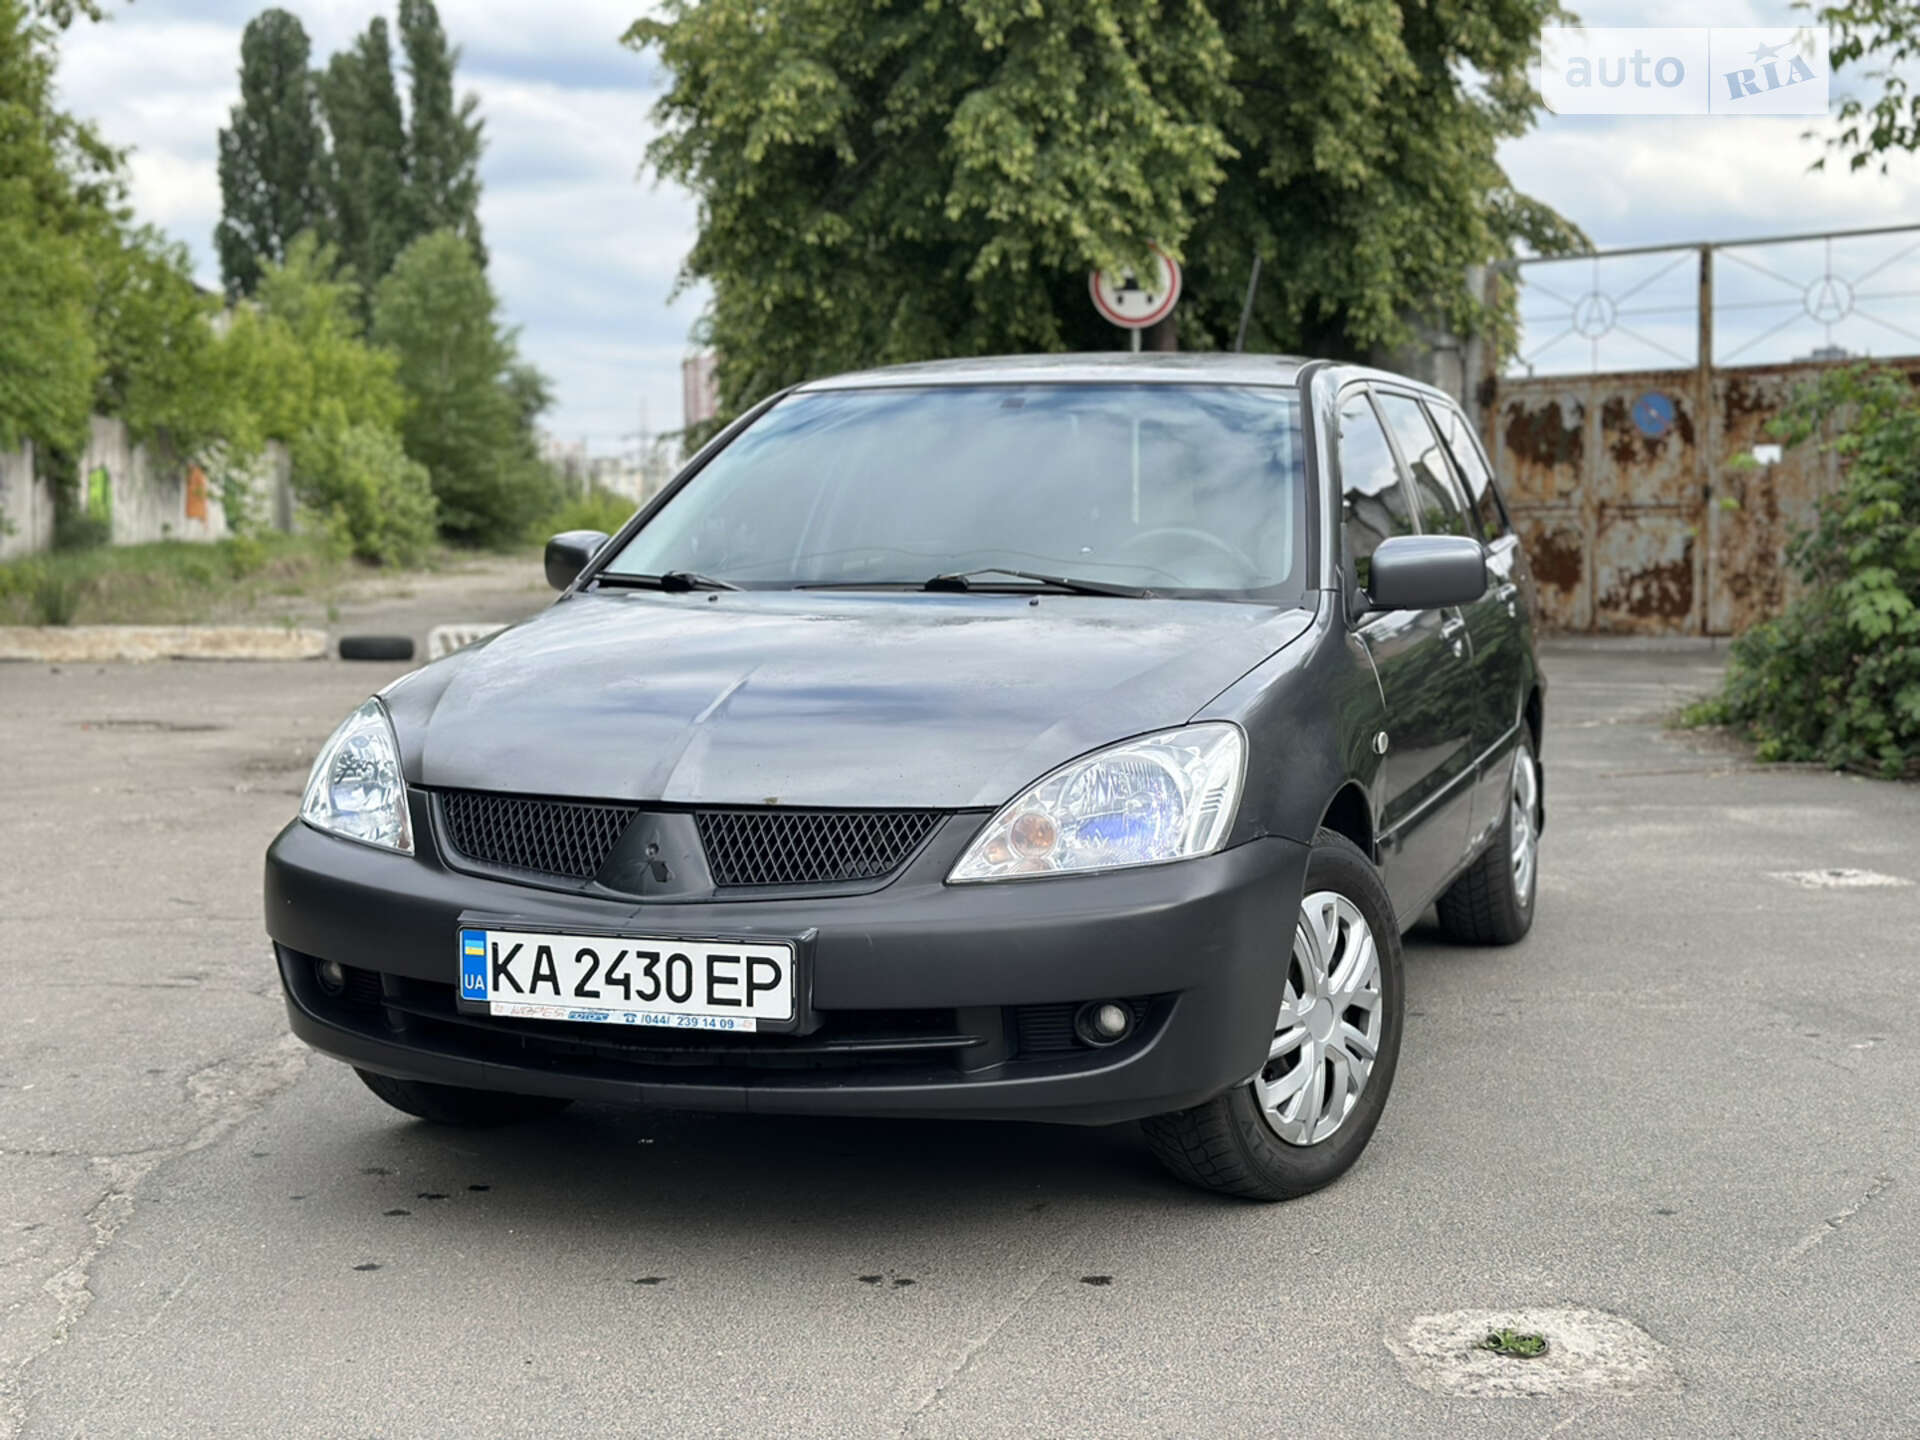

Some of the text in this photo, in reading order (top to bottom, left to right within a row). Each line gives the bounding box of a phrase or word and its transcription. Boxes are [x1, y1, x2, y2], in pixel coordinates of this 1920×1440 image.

[464, 974, 486, 990] UA
[491, 941, 782, 1007] KA 2430 EP
[676, 1016, 698, 1027] 239
[702, 1018, 717, 1028] 14
[720, 1019, 735, 1029] 09
